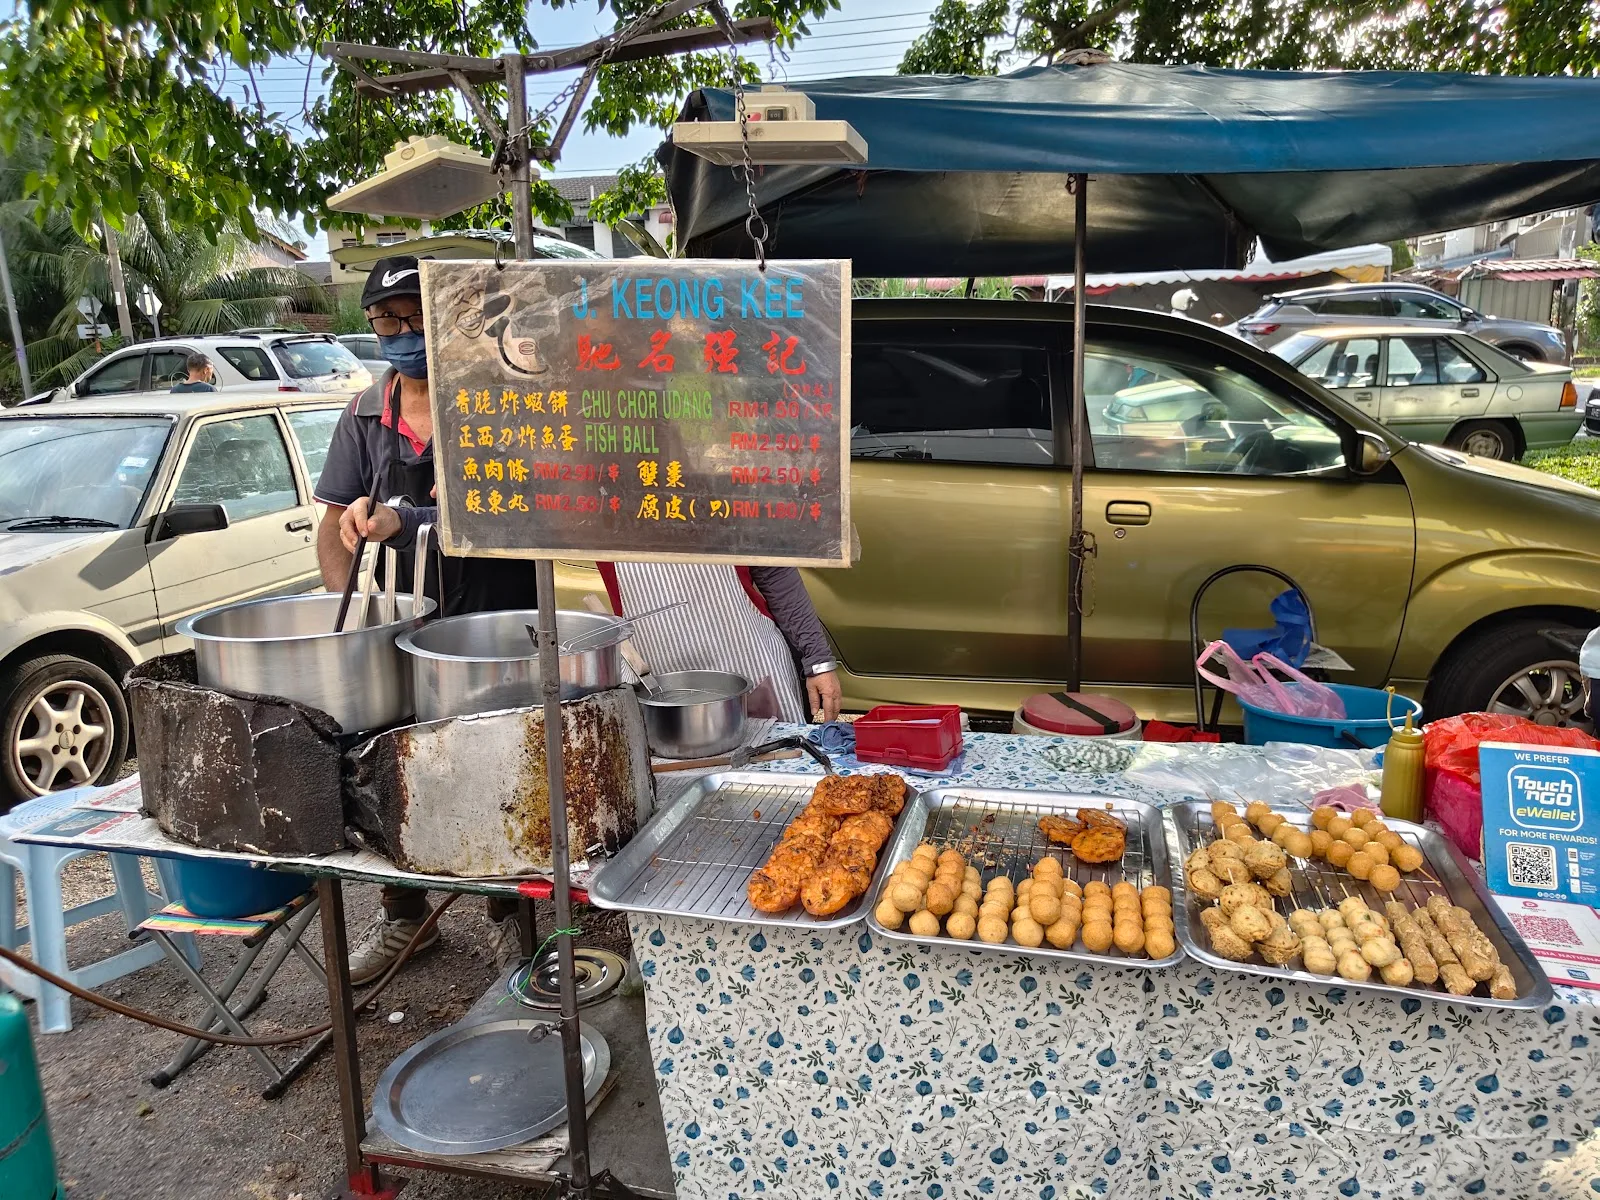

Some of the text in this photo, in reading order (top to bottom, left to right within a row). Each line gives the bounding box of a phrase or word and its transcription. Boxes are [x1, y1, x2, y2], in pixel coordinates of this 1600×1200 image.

[384, 274, 399, 285] NIKE
[572, 277, 805, 320] J. KEONG KEE
[581, 389, 611, 418] CHU
[617, 389, 658, 419] CHOR
[662, 390, 712, 420] UDANG
[585, 425, 617, 453] FISH
[623, 425, 659, 454] BALL
[1514, 752, 1570, 764] WE PREFER
[1514, 775, 1573, 793] Touch
[1516, 806, 1577, 821] eWallet
[1499, 828, 1598, 845] FOR MORE REWARDS!
